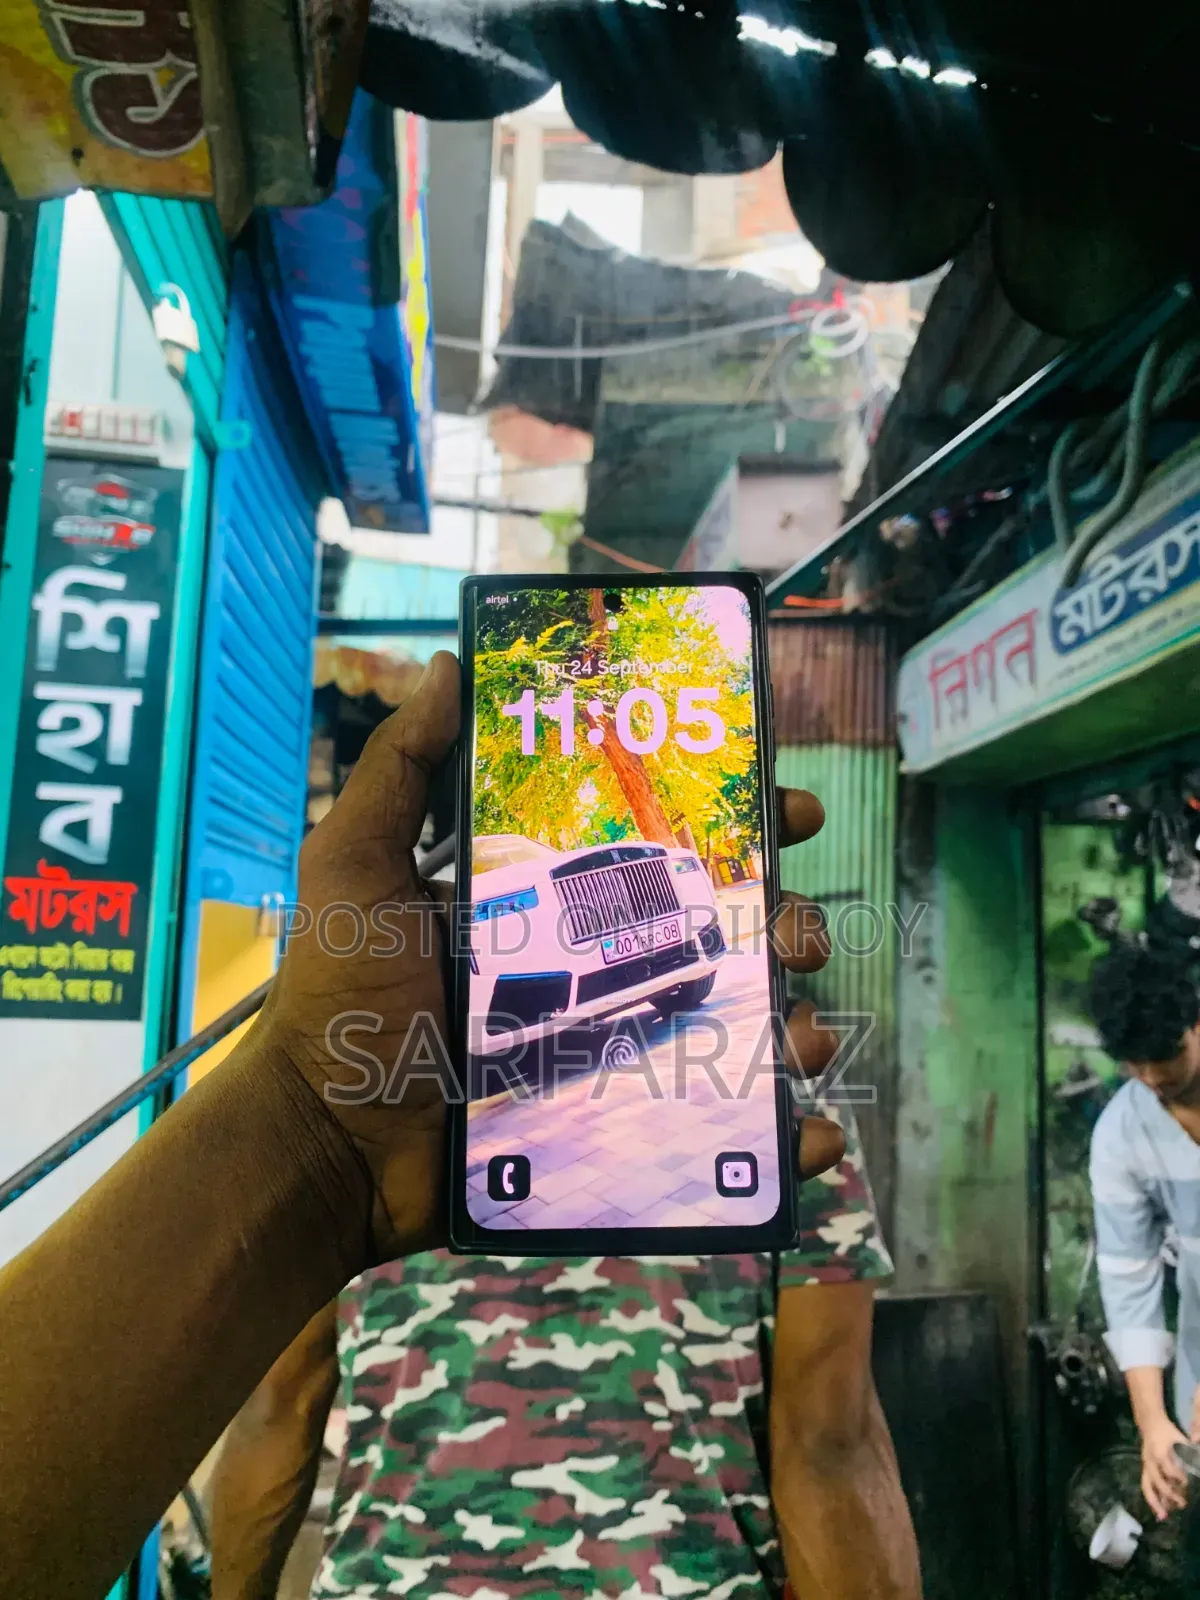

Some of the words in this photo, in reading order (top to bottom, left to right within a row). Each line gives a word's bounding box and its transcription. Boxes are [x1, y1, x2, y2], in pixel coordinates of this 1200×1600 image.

[485, 593, 509, 604] airtel
[534, 659, 566, 675] Thu
[570, 659, 593, 676] 24
[597, 658, 694, 679] September
[502, 687, 726, 756] 11:05
